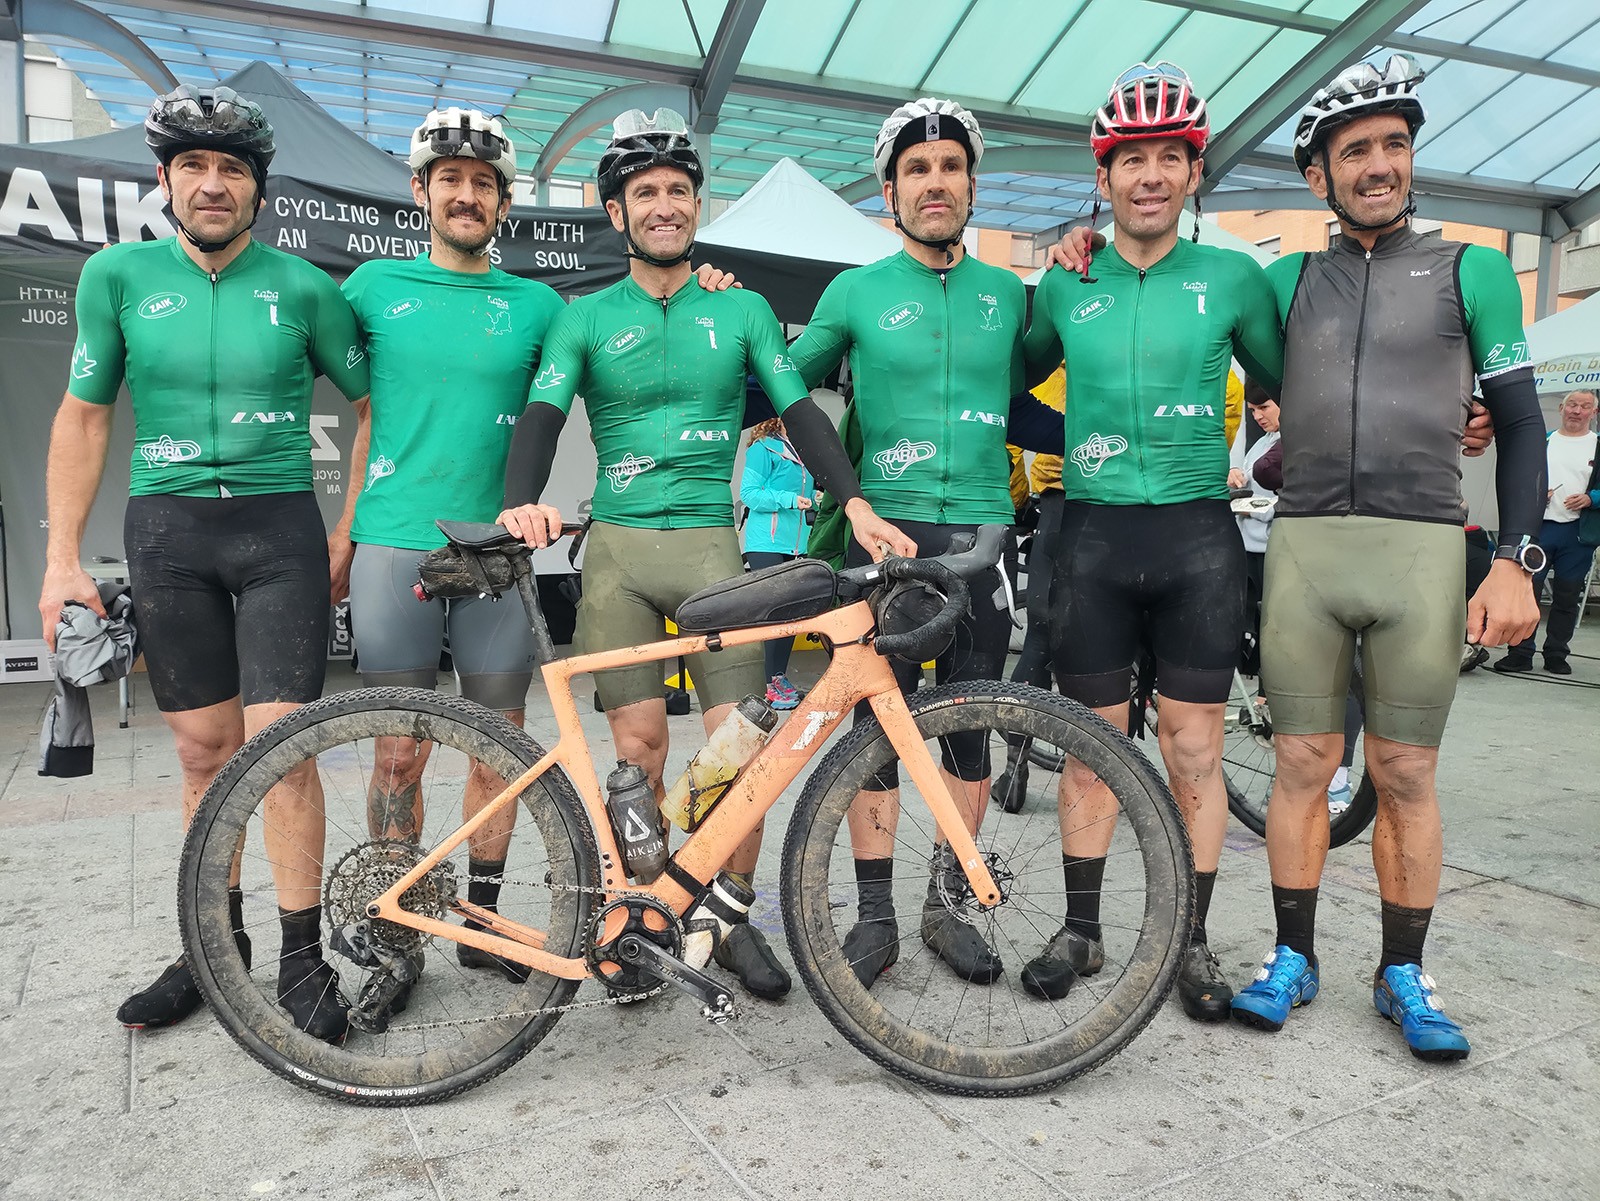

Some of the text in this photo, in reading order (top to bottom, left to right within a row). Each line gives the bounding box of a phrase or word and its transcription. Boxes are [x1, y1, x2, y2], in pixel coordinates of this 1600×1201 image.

[274, 196, 380, 227] CYCLING
[533, 221, 585, 243] WITH
[276, 227, 586, 271] AN ADVENTS SOUL
[1410, 269, 1431, 277] ZAIK
[149, 297, 174, 314] ZAIK
[391, 302, 412, 316] ZAIK
[1079, 300, 1103, 318] ZAIK
[888, 307, 912, 326] ZAIK
[614, 331, 636, 349] ZAIK
[1533, 359, 1582, 374] doain
[1153, 404, 1215, 417] LABA
[679, 429, 730, 441] LABA
[332, 605, 349, 653] Tacx
[919, 699, 955, 714] SWAMPERO
[356, 1087, 393, 1097] SWAMPERO
[393, 1086, 418, 1097] GRAVEL
